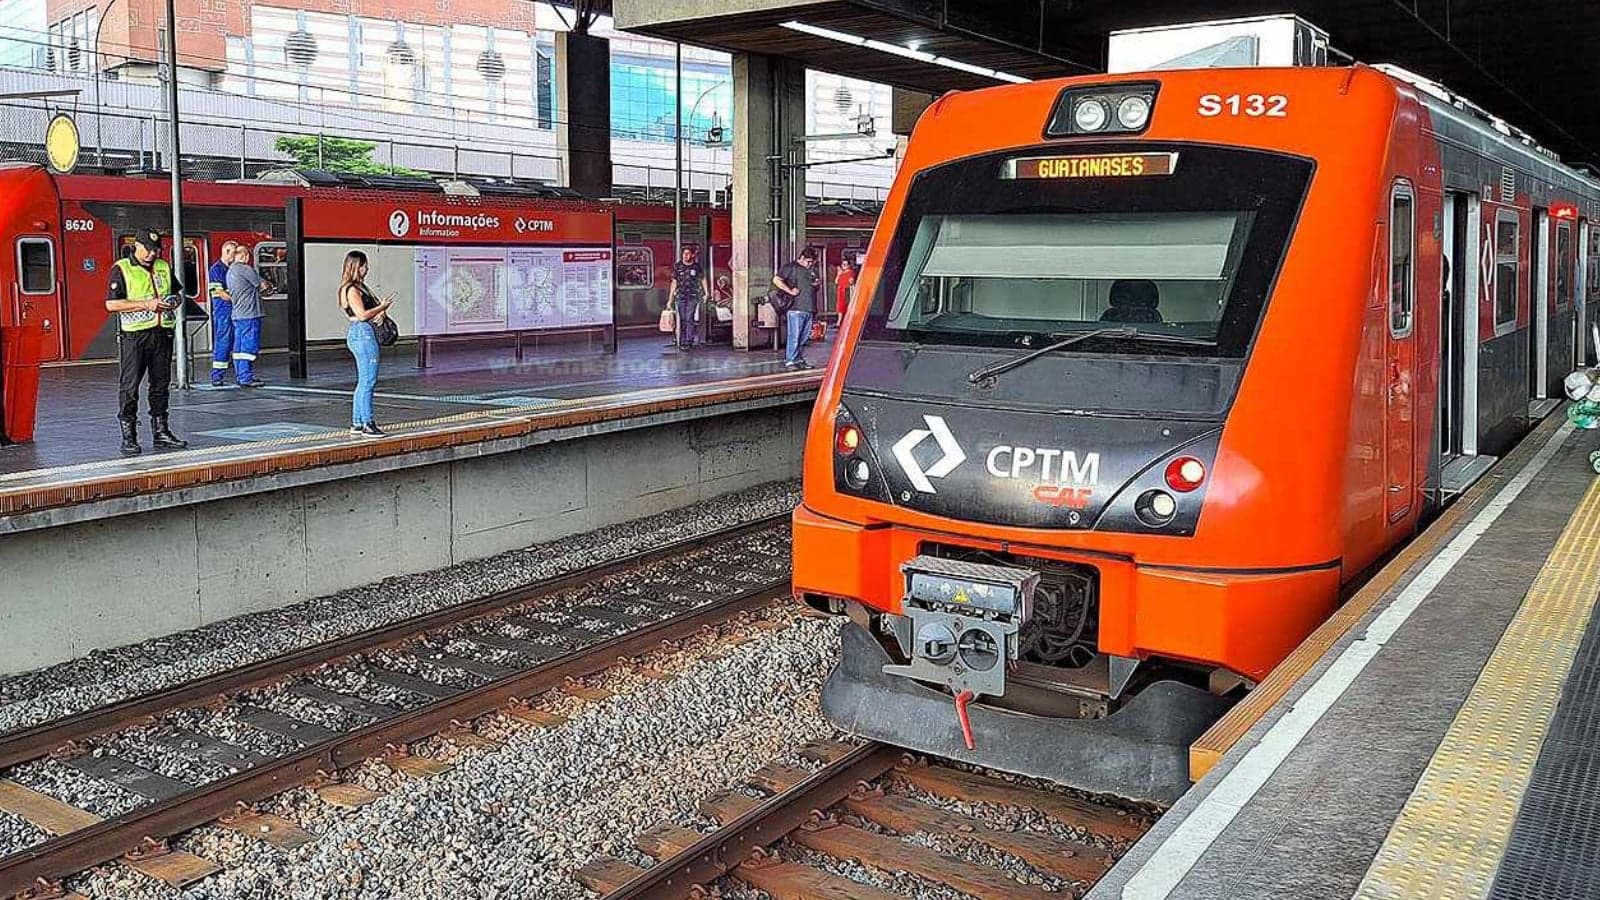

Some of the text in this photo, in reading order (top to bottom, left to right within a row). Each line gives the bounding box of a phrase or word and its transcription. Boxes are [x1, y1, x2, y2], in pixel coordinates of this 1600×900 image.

[1198, 94, 1288, 117] S132
[1038, 157, 1144, 178] GUAIANASES
[65, 219, 94, 231] 8620
[418, 211, 499, 230] Informações
[528, 219, 553, 231] CPTM
[419, 228, 459, 237] Information
[986, 445, 1099, 485] CPTM
[1033, 486, 1092, 508] CAF
